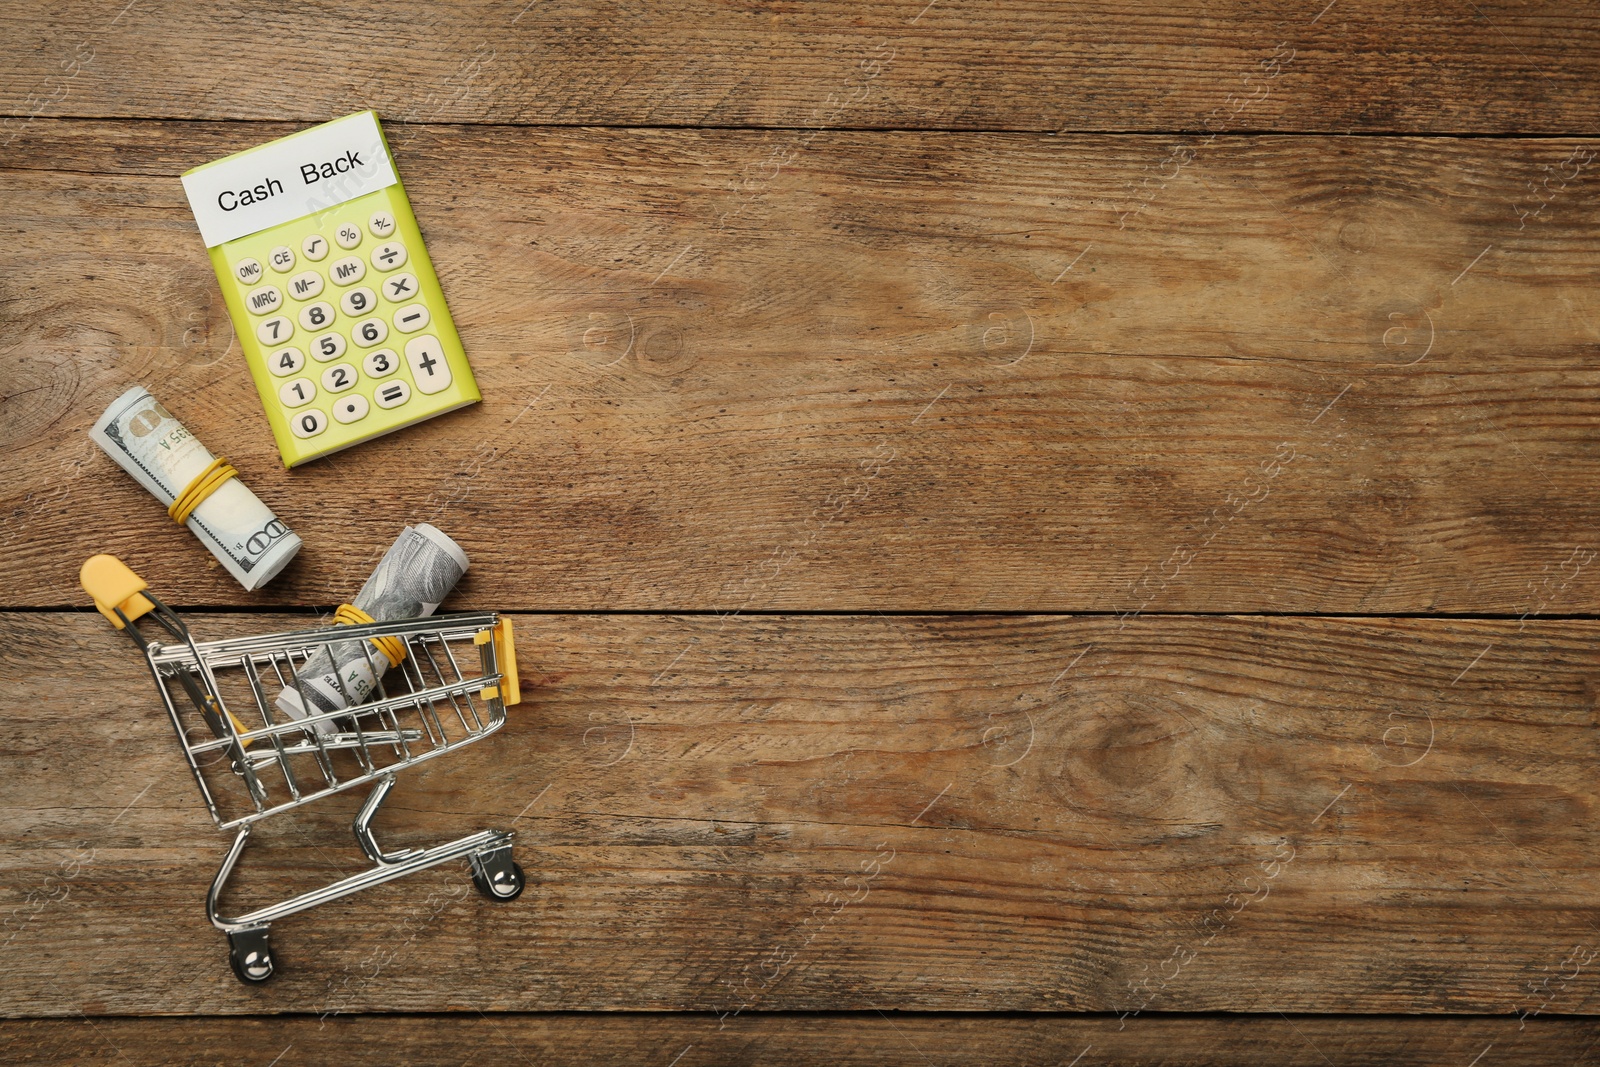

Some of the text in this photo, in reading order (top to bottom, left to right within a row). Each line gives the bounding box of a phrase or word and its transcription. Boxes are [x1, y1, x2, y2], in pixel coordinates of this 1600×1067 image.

[218, 151, 364, 211] Cash Back
[240, 263, 259, 278] ON/C
[274, 252, 290, 265] CE
[252, 291, 277, 308] MRC
[337, 263, 357, 279] M+
[266, 321, 280, 339] 7
[309, 307, 326, 326] 8
[350, 293, 367, 311] 9
[280, 353, 295, 369] 4
[320, 337, 337, 356] 5
[362, 323, 379, 342] 6
[292, 383, 305, 401] 1
[332, 369, 350, 388] 2
[373, 354, 390, 372] 3
[302, 415, 318, 433] 0
[323, 675, 345, 697] OTE
[347, 670, 359, 683] A
